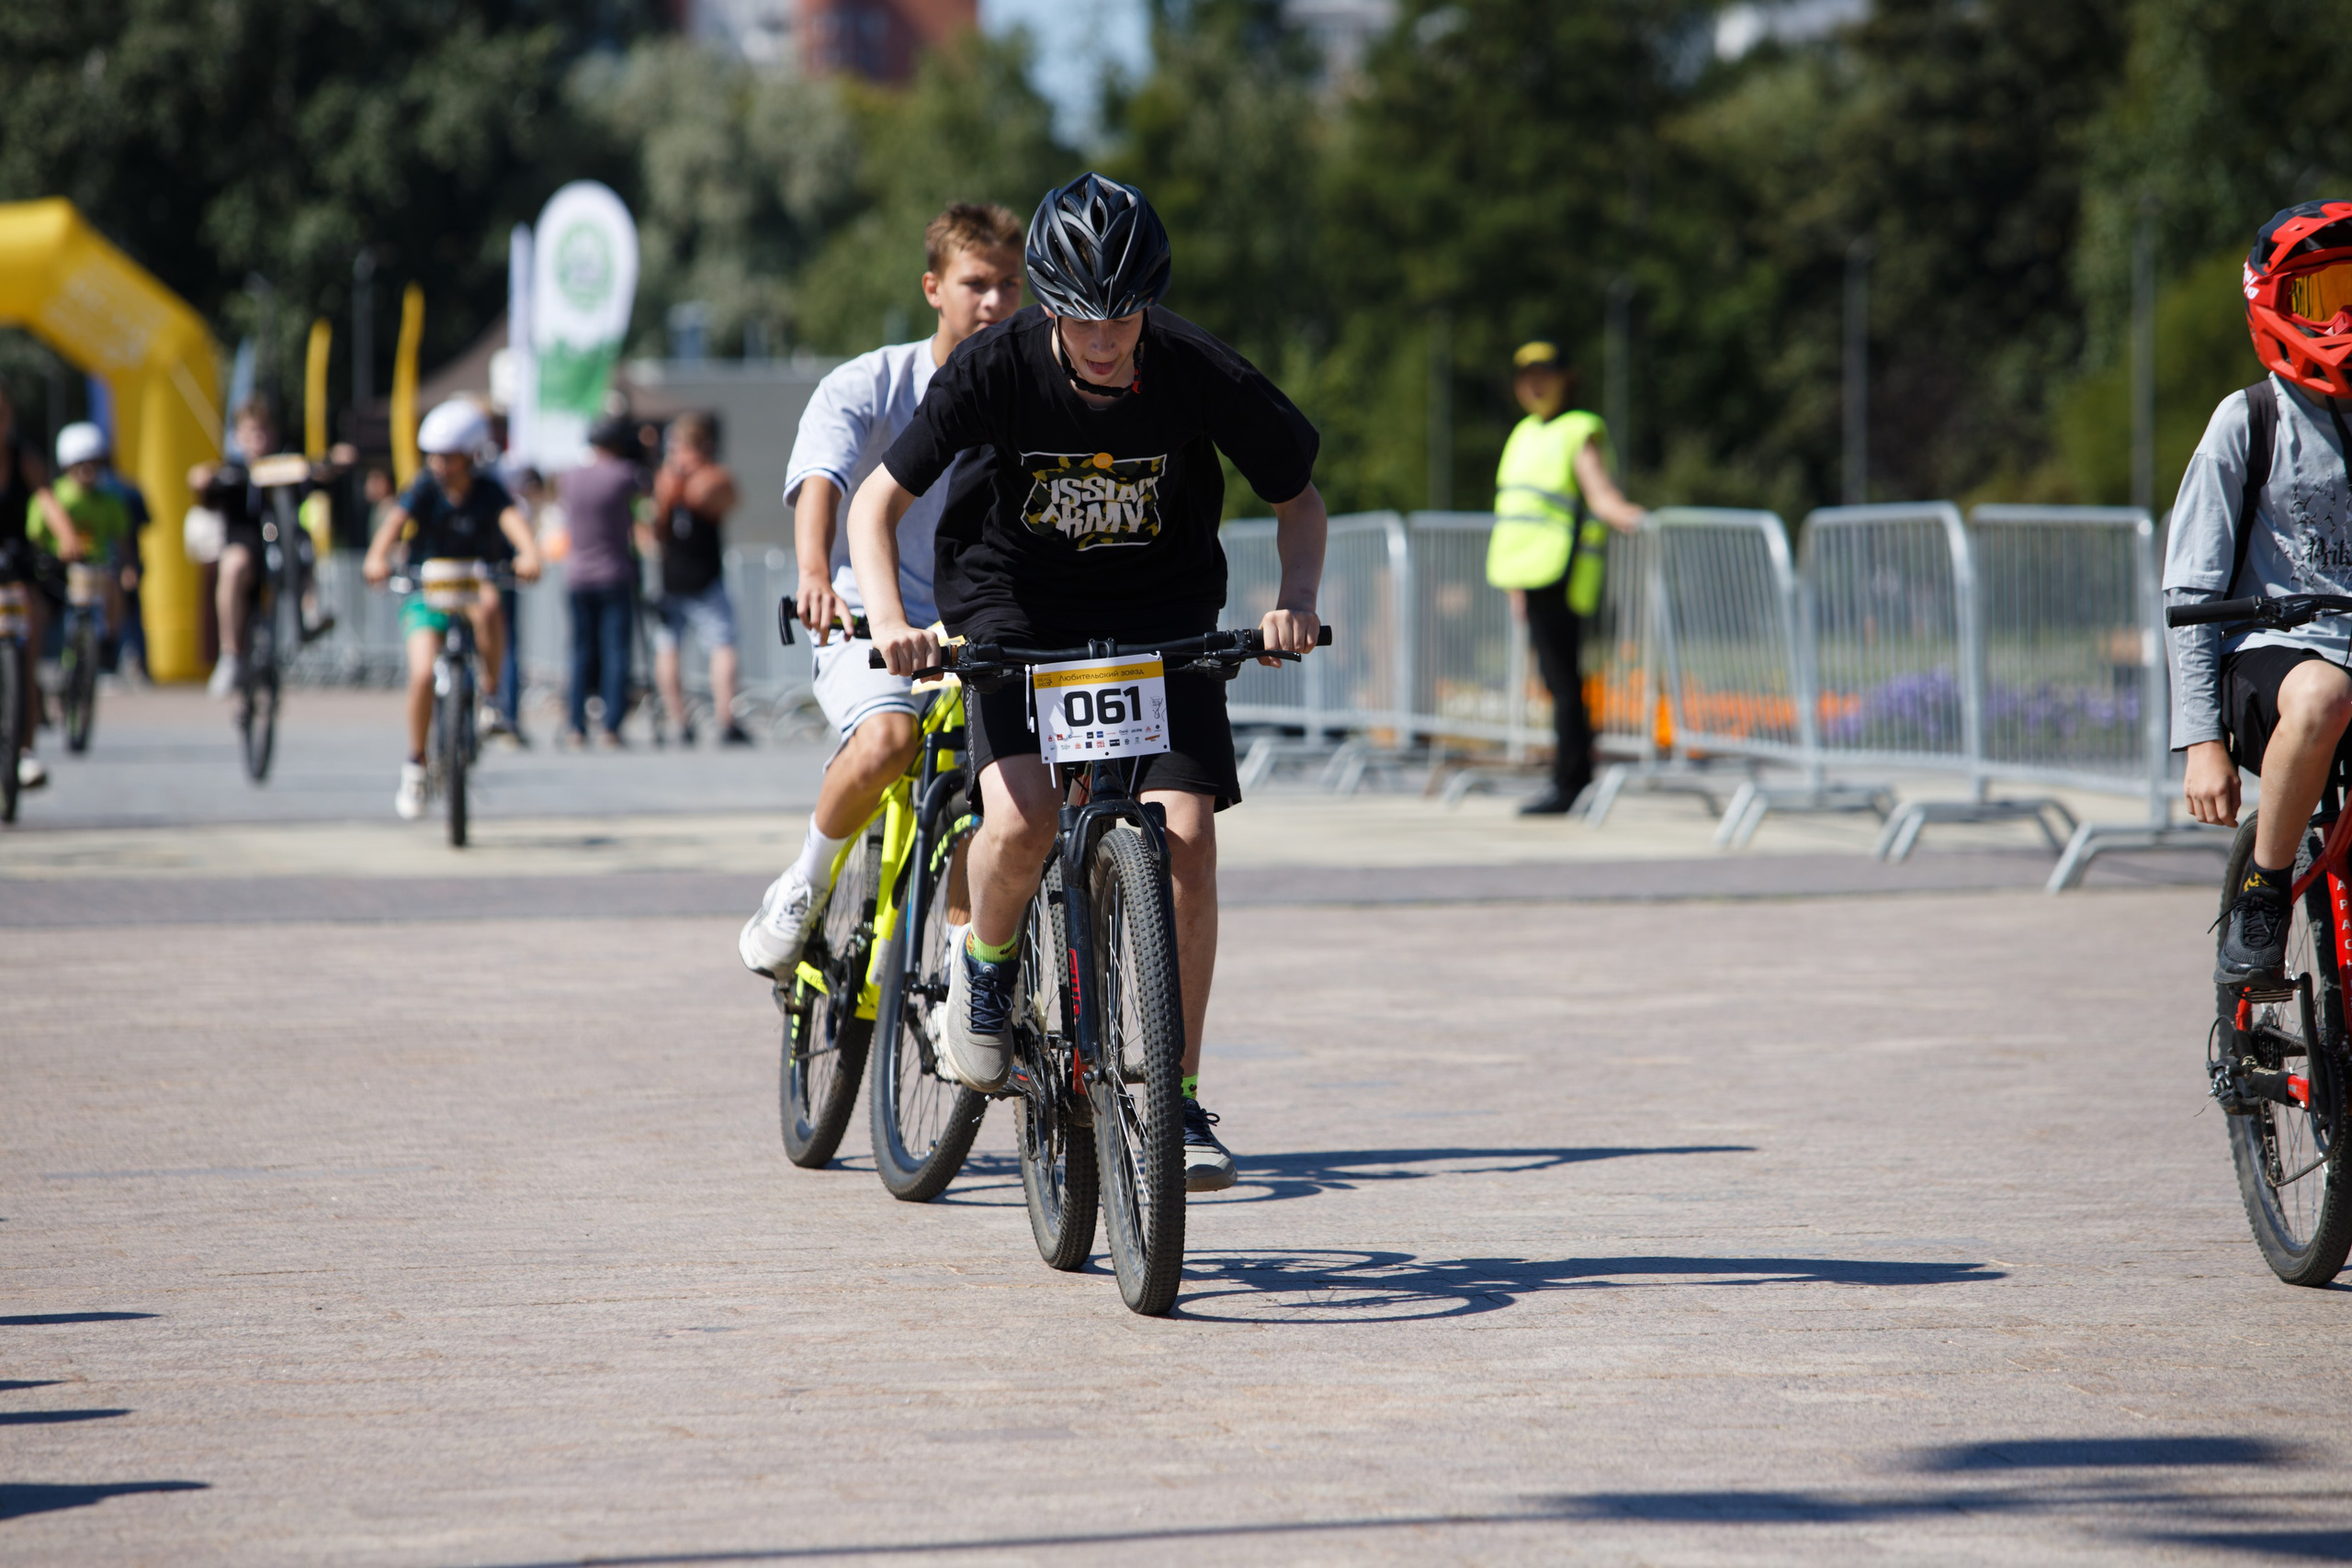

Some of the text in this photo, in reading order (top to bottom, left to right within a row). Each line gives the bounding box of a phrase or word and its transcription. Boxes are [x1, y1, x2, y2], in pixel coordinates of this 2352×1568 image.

[1039, 490, 1144, 540] ARMY
[1059, 671, 1119, 682] Любительский
[1064, 686, 1141, 727] 061
[2336, 878, 2352, 989] APACH
